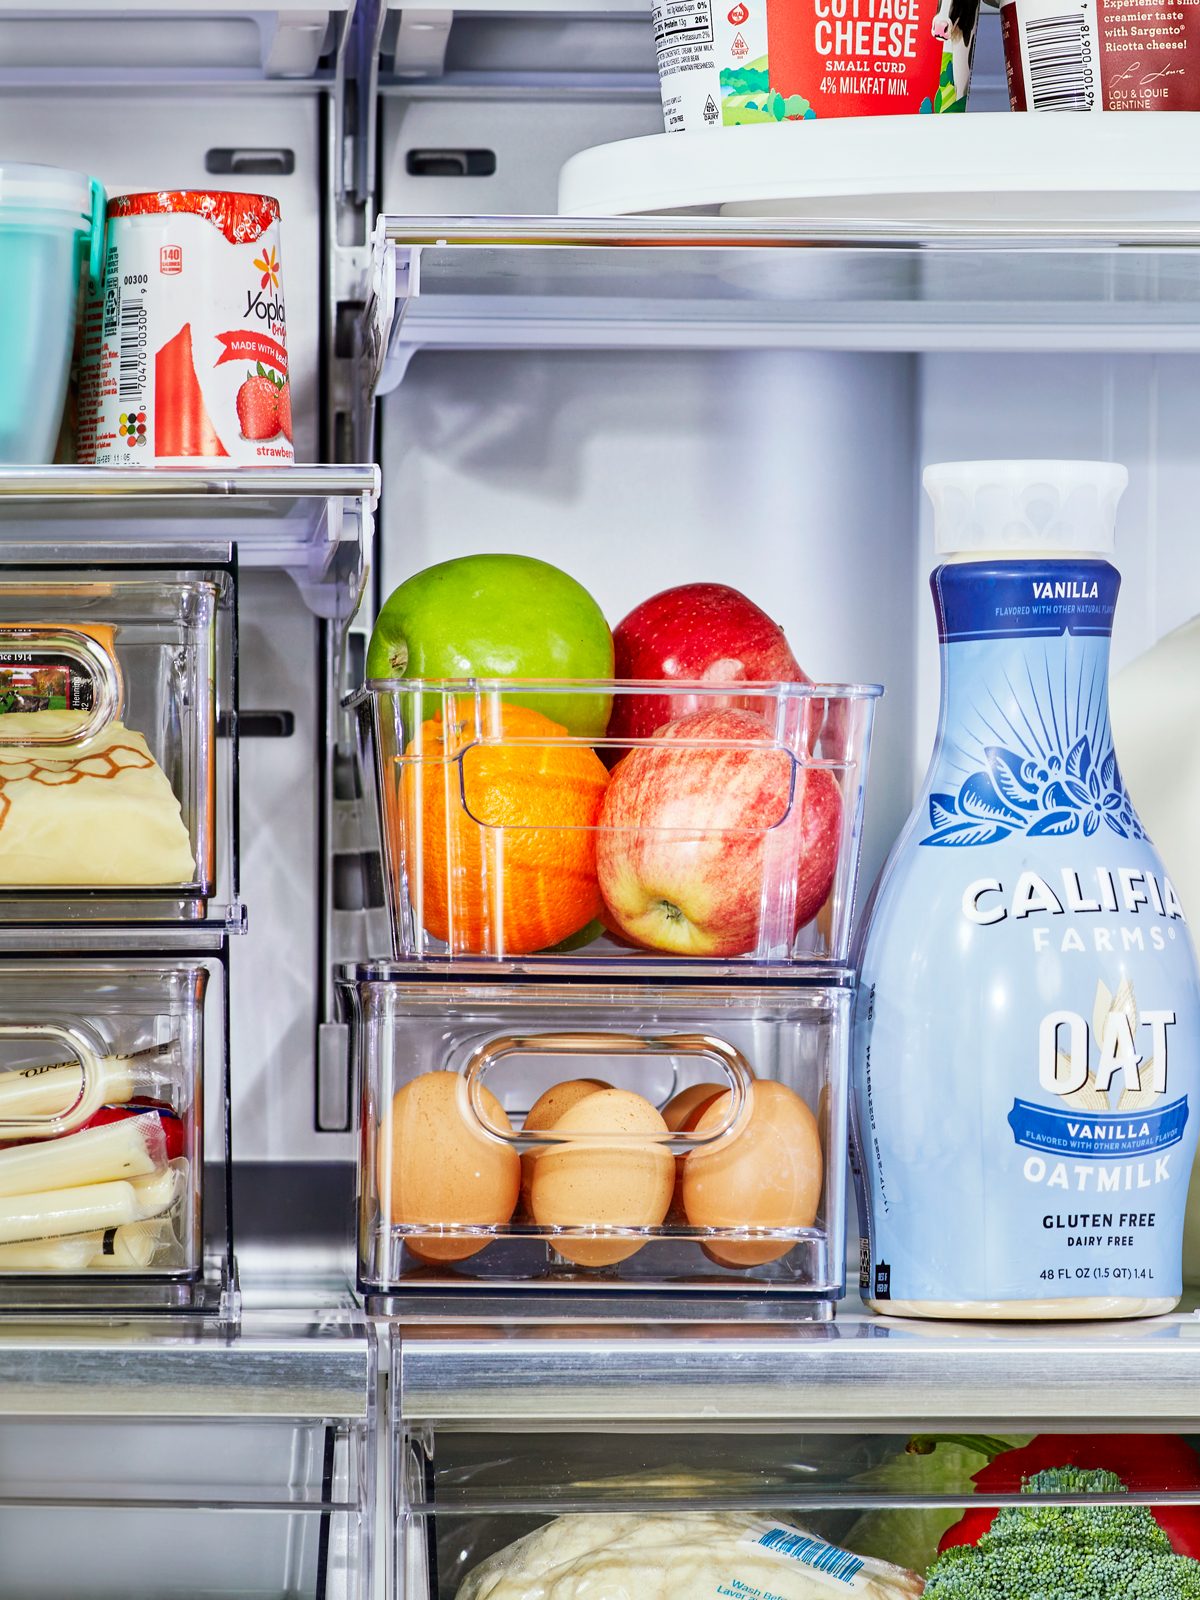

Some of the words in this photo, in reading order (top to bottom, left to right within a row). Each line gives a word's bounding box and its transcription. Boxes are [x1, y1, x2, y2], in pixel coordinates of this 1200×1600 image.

[696, 2, 707, 10] 0%
[1103, 0, 1164, 9] Experience
[694, 16, 708, 24] 26%
[1103, 12, 1153, 23] creamier
[1155, 11, 1184, 20] taste
[814, 20, 919, 58] CHEESE
[1104, 26, 1129, 38] with
[1080, 25, 1092, 63] 00618
[1105, 40, 1144, 52] Ricotta
[1146, 39, 1187, 50] cheese!
[825, 60, 870, 71] SMALL
[873, 61, 907, 73] CURD
[819, 76, 837, 94] 4%
[839, 77, 886, 95] MILKFAT
[887, 79, 909, 96] MIN.
[1083, 69, 1094, 106] 46100
[1108, 89, 1128, 99] LOU
[1130, 89, 1138, 99] &
[1139, 88, 1169, 98] LOUIE
[1109, 99, 1151, 110] GENTINE
[163, 248, 180, 260] 140
[123, 274, 148, 286] 00300
[138, 309, 147, 347] 00300
[231, 341, 257, 352] MADE
[257, 342, 276, 356] WITH
[138, 352, 147, 389] 70470
[1033, 581, 1099, 599] VANILLA
[995, 606, 1030, 617] FLAVORED
[1032, 605, 1051, 615] WITH
[1053, 604, 1076, 614] OTHER
[1076, 604, 1101, 614] NATURAL
[14, 653, 32, 662] 1914
[72, 677, 81, 706] Henning
[961, 866, 1186, 926] CALIFIA
[1039, 1010, 1176, 1096] OAT
[1067, 1122, 1150, 1140] VANILLA
[1025, 1130, 1068, 1147] FLAVORED
[1070, 1140, 1092, 1150] WITH
[1093, 1141, 1120, 1151] OTHER
[1121, 1135, 1154, 1149] NATURAL
[1023, 1154, 1172, 1193] OATMILK
[1042, 1213, 1113, 1229] GLUTEN
[1119, 1213, 1156, 1228] FREE
[1067, 1236, 1103, 1247] DAIRY
[1107, 1236, 1134, 1246] FREE
[1040, 1268, 1055, 1280] 48
[1058, 1268, 1072, 1279] FL
[1075, 1267, 1090, 1278] OZ
[1093, 1267, 1110, 1280] (1.5
[1112, 1267, 1132, 1280] QT)
[1134, 1268, 1146, 1279] 1.4
[1148, 1268, 1154, 1279] L
[731, 1579, 761, 1597] Wash
